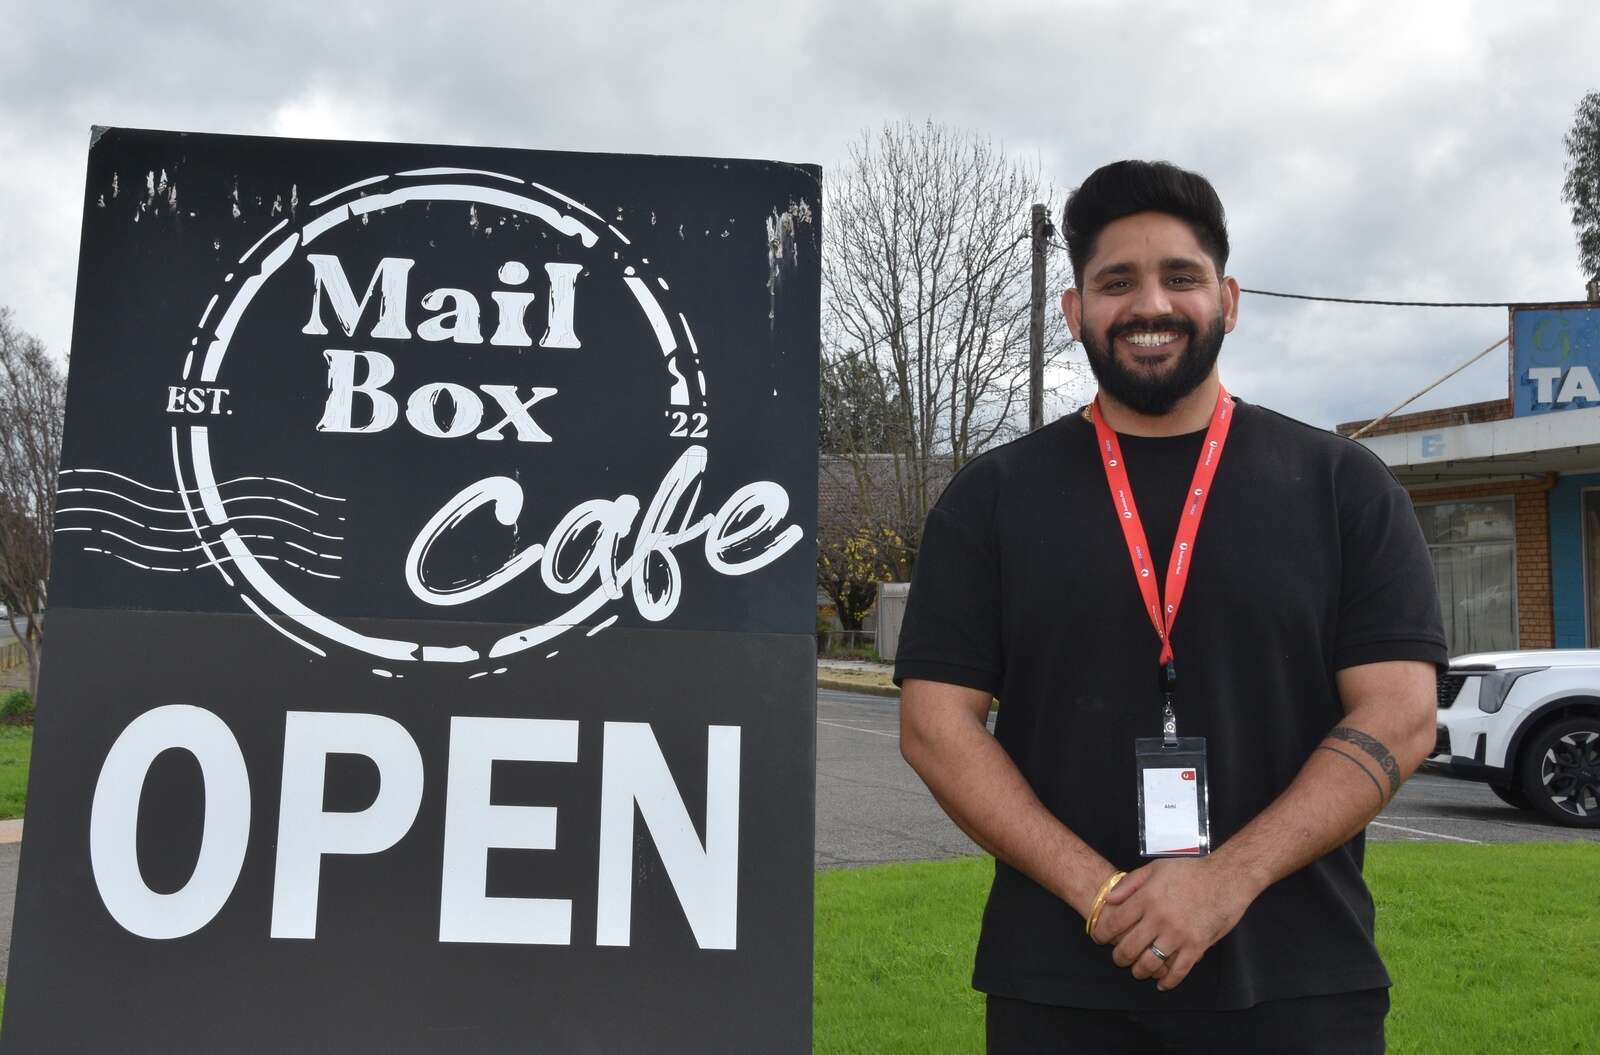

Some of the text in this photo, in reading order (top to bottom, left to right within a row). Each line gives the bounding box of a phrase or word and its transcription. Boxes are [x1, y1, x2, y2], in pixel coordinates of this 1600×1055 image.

[302, 254, 583, 348] Mail
[166, 386, 233, 414] EST.
[316, 350, 558, 442] Box
[405, 445, 803, 621] Cafe
[90, 704, 741, 950] OPEN
